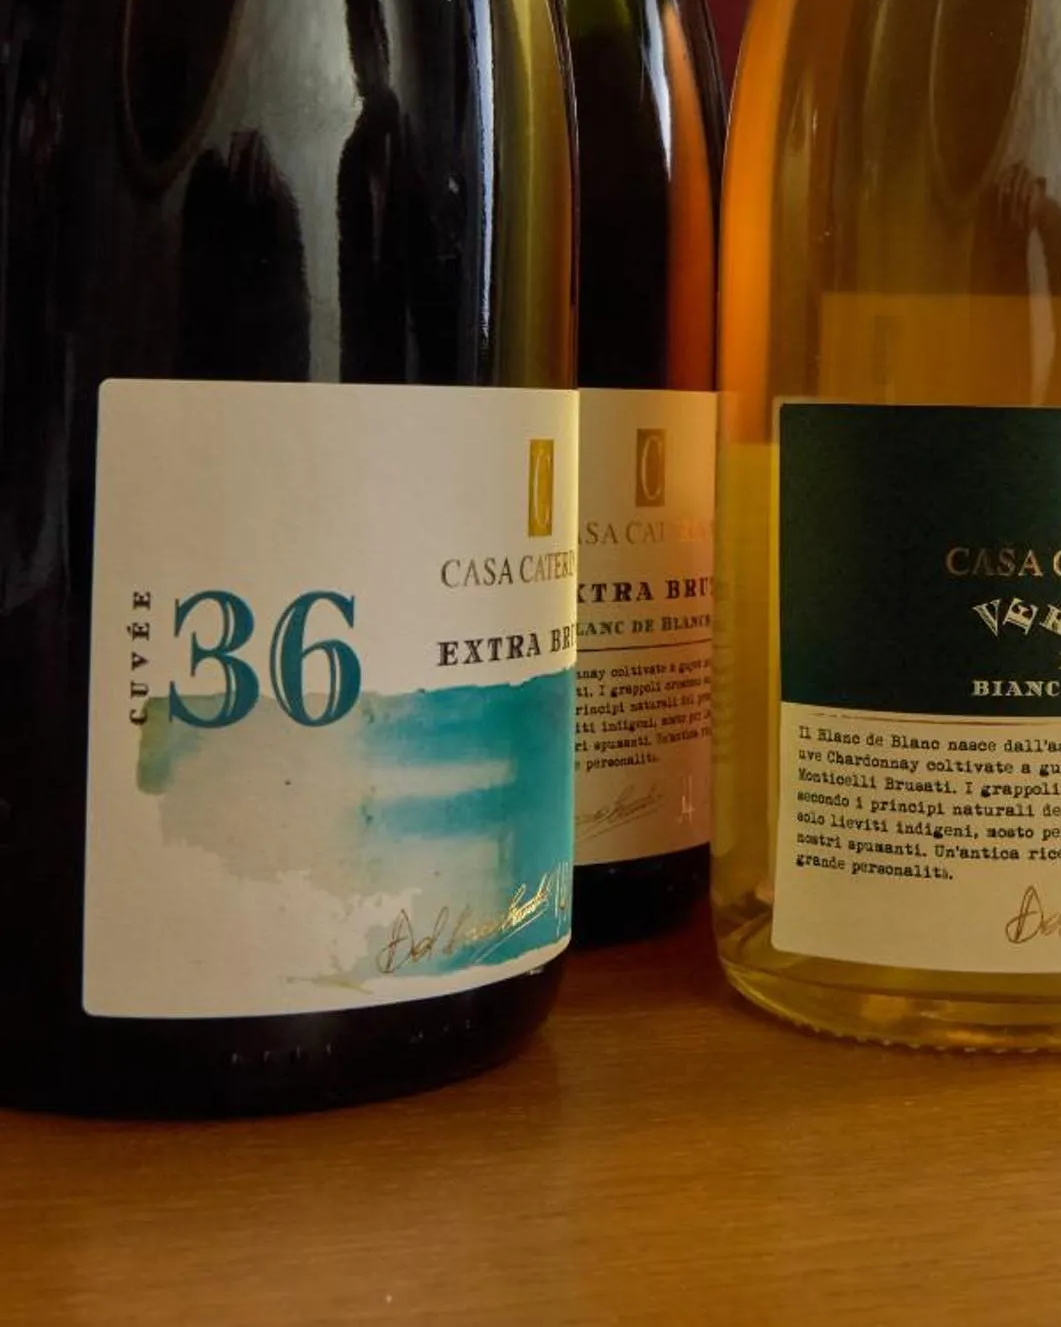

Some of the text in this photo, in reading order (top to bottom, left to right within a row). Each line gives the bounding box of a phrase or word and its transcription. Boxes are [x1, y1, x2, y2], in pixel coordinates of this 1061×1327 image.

[441, 557, 514, 588] CASA
[945, 547, 1043, 576] CASA
[127, 591, 151, 726] CUVÉE
[168, 590, 361, 728] 36
[437, 632, 541, 666] EXTRA
[817, 728, 861, 745] Blanc
[866, 732, 884, 747] de
[891, 734, 940, 750] Blanc
[948, 738, 996, 752] nasce
[798, 749, 822, 761] uve
[827, 750, 919, 773] Chardonnay
[927, 760, 1014, 774] coltivate
[1021, 764, 1034, 775] a
[884, 777, 957, 795] Brusati.
[981, 780, 1060, 798] grappoli
[797, 789, 850, 808] secondo
[871, 798, 946, 816] principi
[953, 802, 1034, 817] naturali
[797, 811, 825, 825] solo
[830, 814, 889, 833] lieviti
[896, 821, 979, 840] indigeni,
[987, 825, 1034, 839] mosto
[797, 832, 842, 850] nostri
[848, 839, 928, 858] spumanti.
[934, 845, 1020, 861] Un'antica
[796, 853, 846, 871] grande
